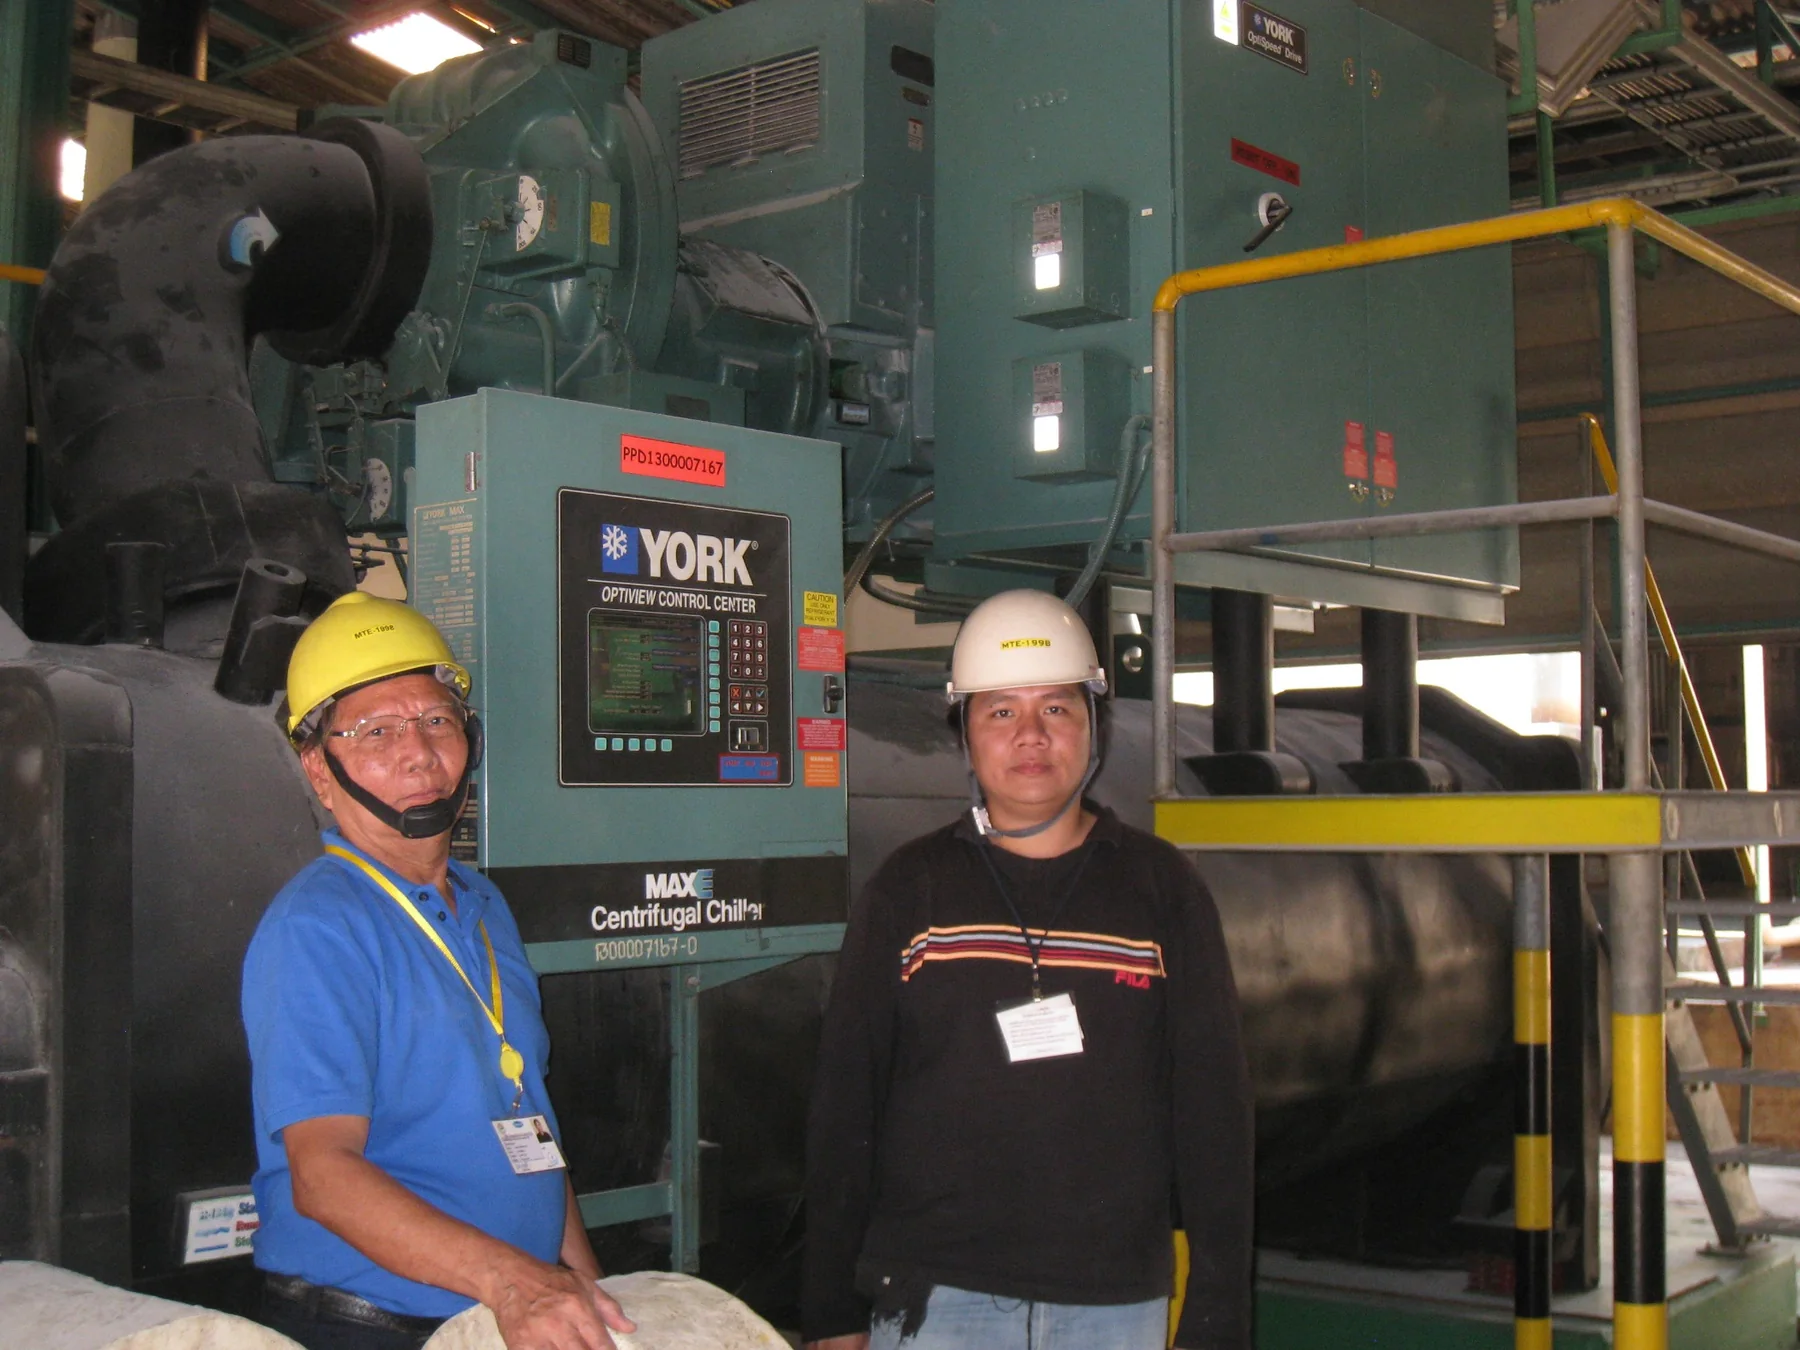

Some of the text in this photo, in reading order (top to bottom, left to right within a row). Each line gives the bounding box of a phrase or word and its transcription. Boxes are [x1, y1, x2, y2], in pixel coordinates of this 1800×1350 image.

[1263, 16, 1294, 46] YORK
[1248, 30, 1302, 64] OptiSpeed Drive
[623, 446, 724, 476] PPD1300007167
[639, 527, 753, 586] YORK
[601, 586, 756, 613] OPTIVIEW CONTROL CENTER
[733, 624, 763, 634] 1 2 3
[732, 638, 763, 648] 4 5 6
[732, 652, 763, 662] 7 8 9
[745, 667, 751, 675] 0
[591, 900, 701, 931] Centrifugal
[1114, 969, 1151, 989] FILA
